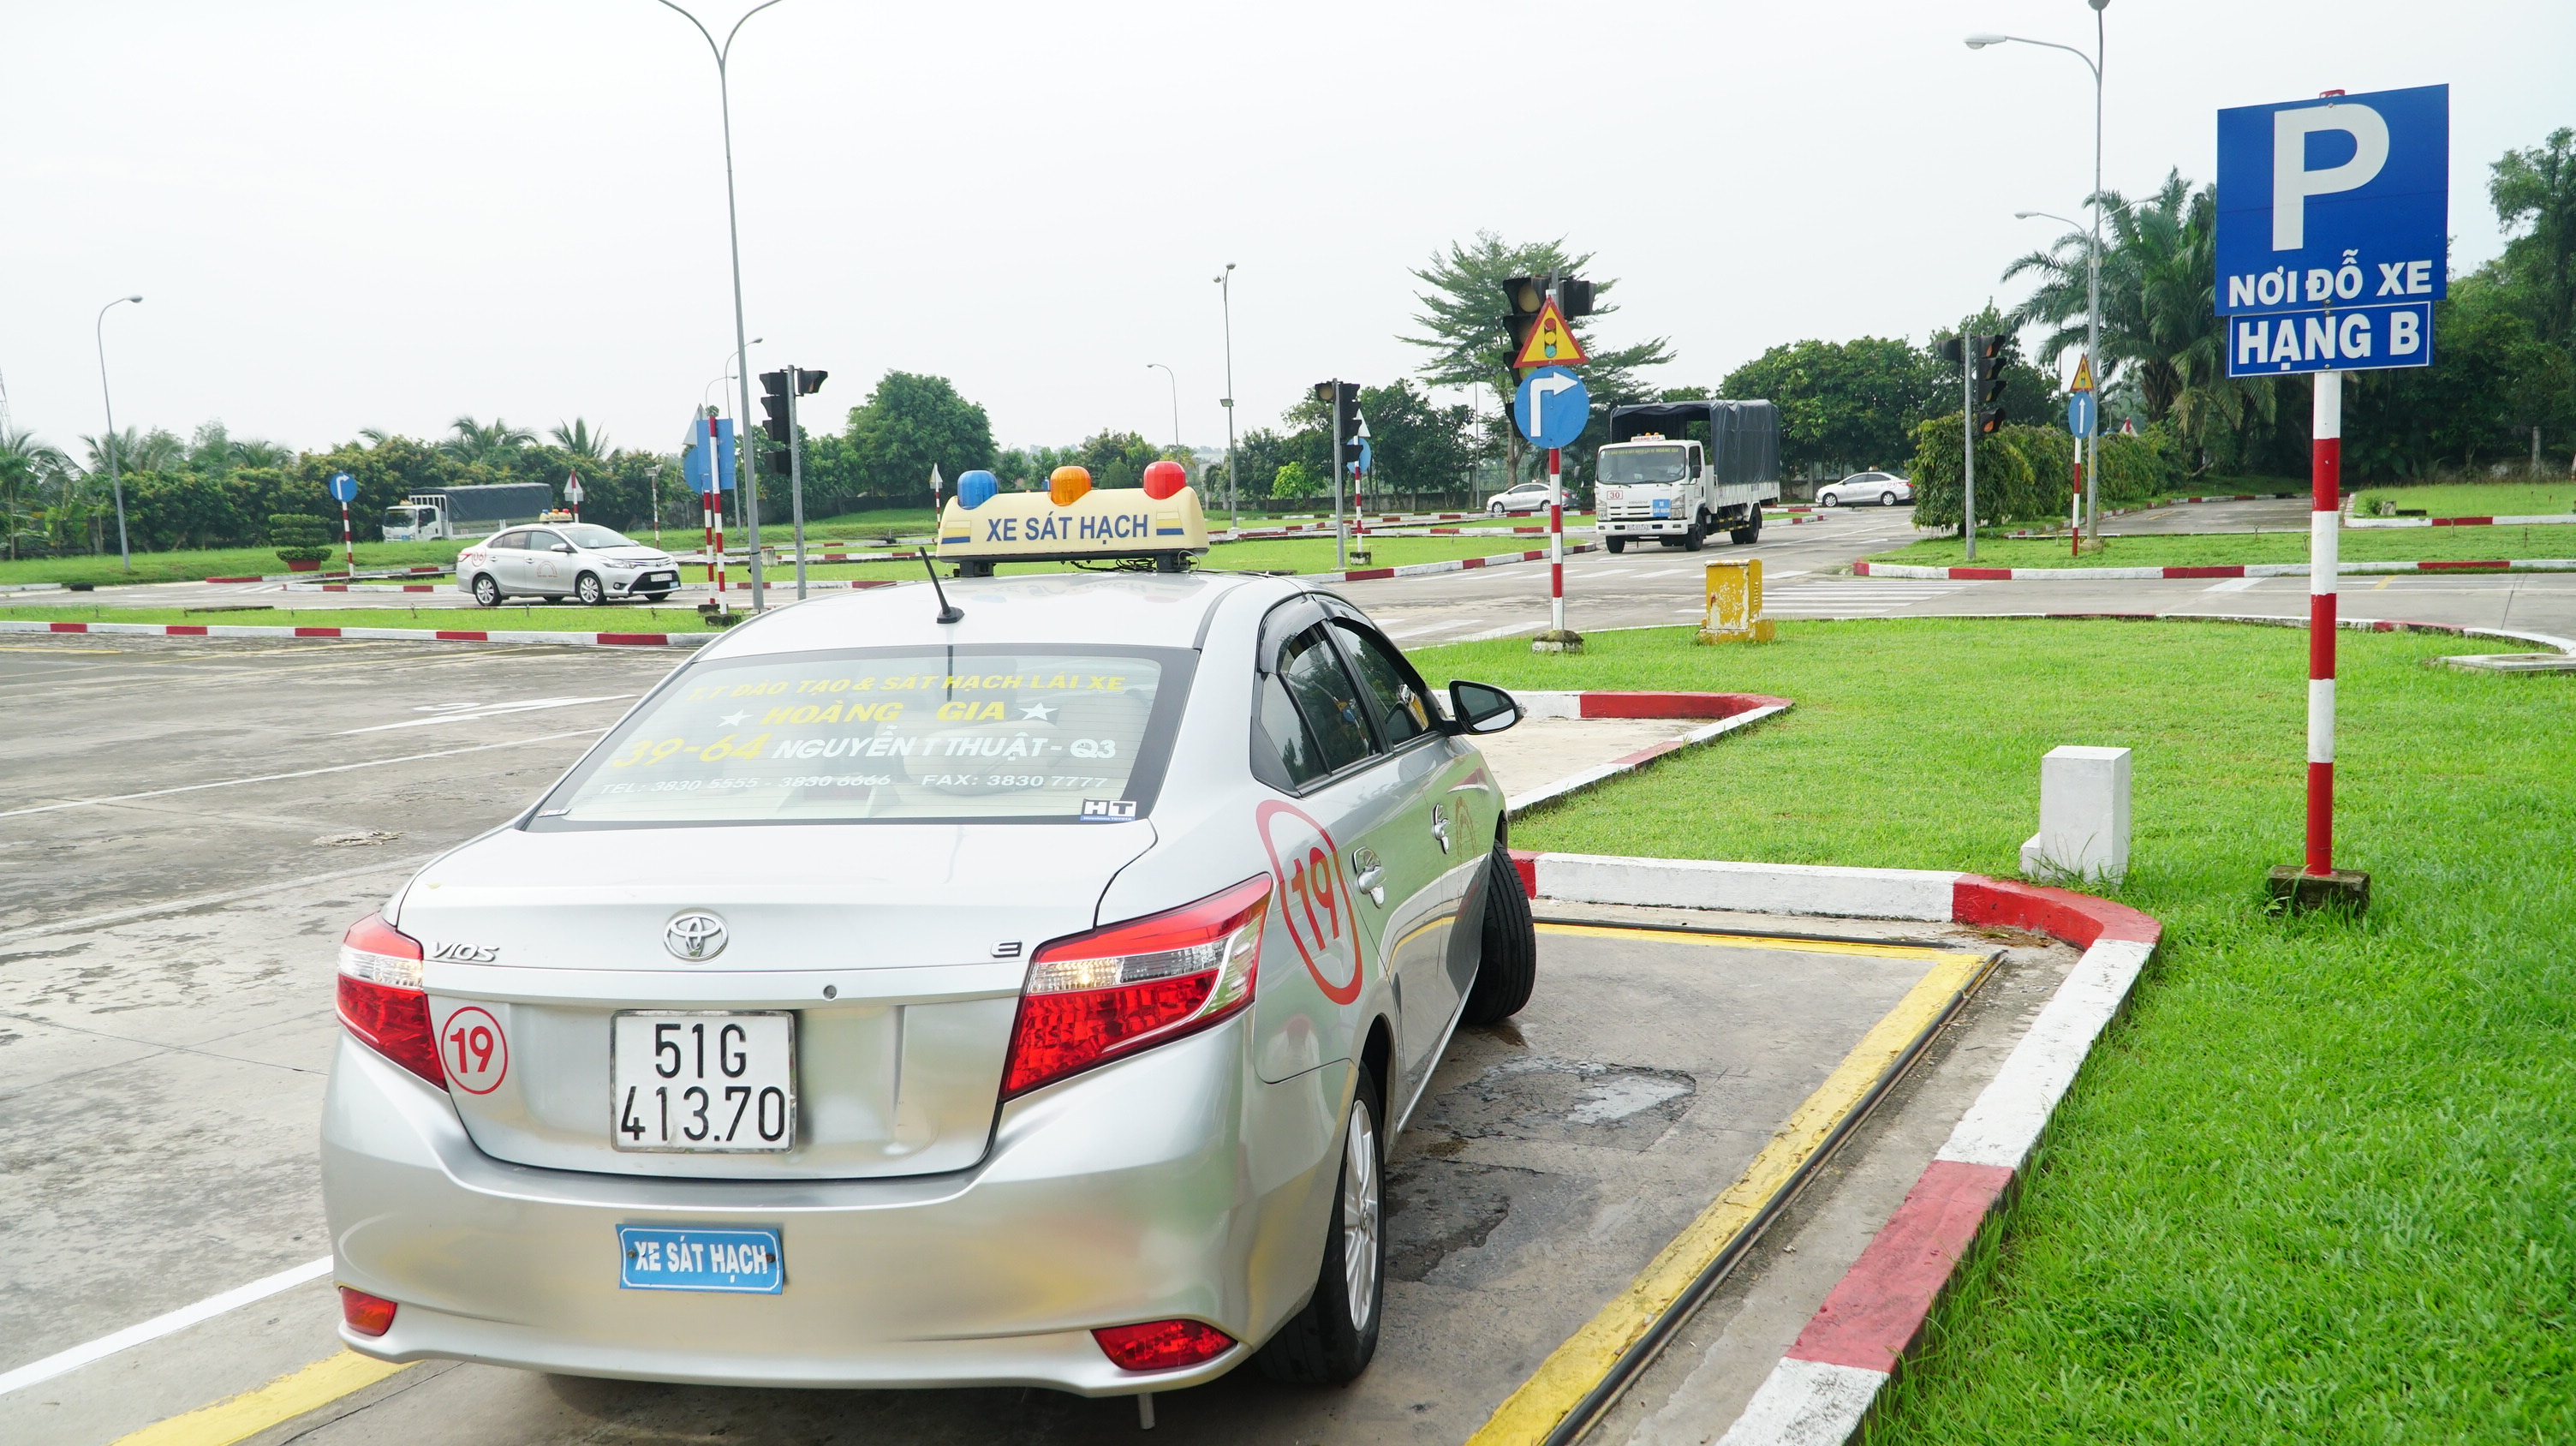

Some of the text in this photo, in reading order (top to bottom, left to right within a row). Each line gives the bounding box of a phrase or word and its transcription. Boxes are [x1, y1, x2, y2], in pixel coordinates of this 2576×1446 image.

[2272, 103, 2390, 252] P
[2228, 248, 2432, 308] NƠI ĐỖ XE
[2238, 311, 2420, 371] HẠNG B
[986, 511, 1148, 545] XE SÁT HẠCH
[730, 678, 789, 698] ĐÀO
[796, 679, 850, 696] TẠO
[852, 677, 876, 691] &
[880, 672, 939, 691] SÁT
[941, 675, 1023, 692] HẠCH
[1029, 672, 1079, 690] LÁI
[1086, 676, 1126, 690] XE
[760, 700, 1005, 726] HOÀNG GIA
[612, 732, 772, 768] 39-64
[771, 724, 917, 759] NGUYỄN
[1070, 738, 1117, 759] Q3
[599, 783, 647, 795] TEL:
[650, 780, 702, 792] 3830
[707, 778, 760, 789] 5555
[778, 775, 835, 788] 3830
[837, 774, 891, 787] 6666
[921, 774, 979, 786] FAX:
[987, 775, 1044, 787] 3830
[1052, 776, 1108, 788] 7777
[1084, 800, 1136, 816] HT
[1291, 847, 1339, 951] 19
[431, 941, 500, 962] VIOS
[991, 940, 1023, 958] E
[450, 1026, 494, 1073] 19
[655, 1024, 747, 1079] 51G
[621, 1085, 785, 1142] 413.70
[634, 1234, 768, 1283] XE SÁT HẠCH
